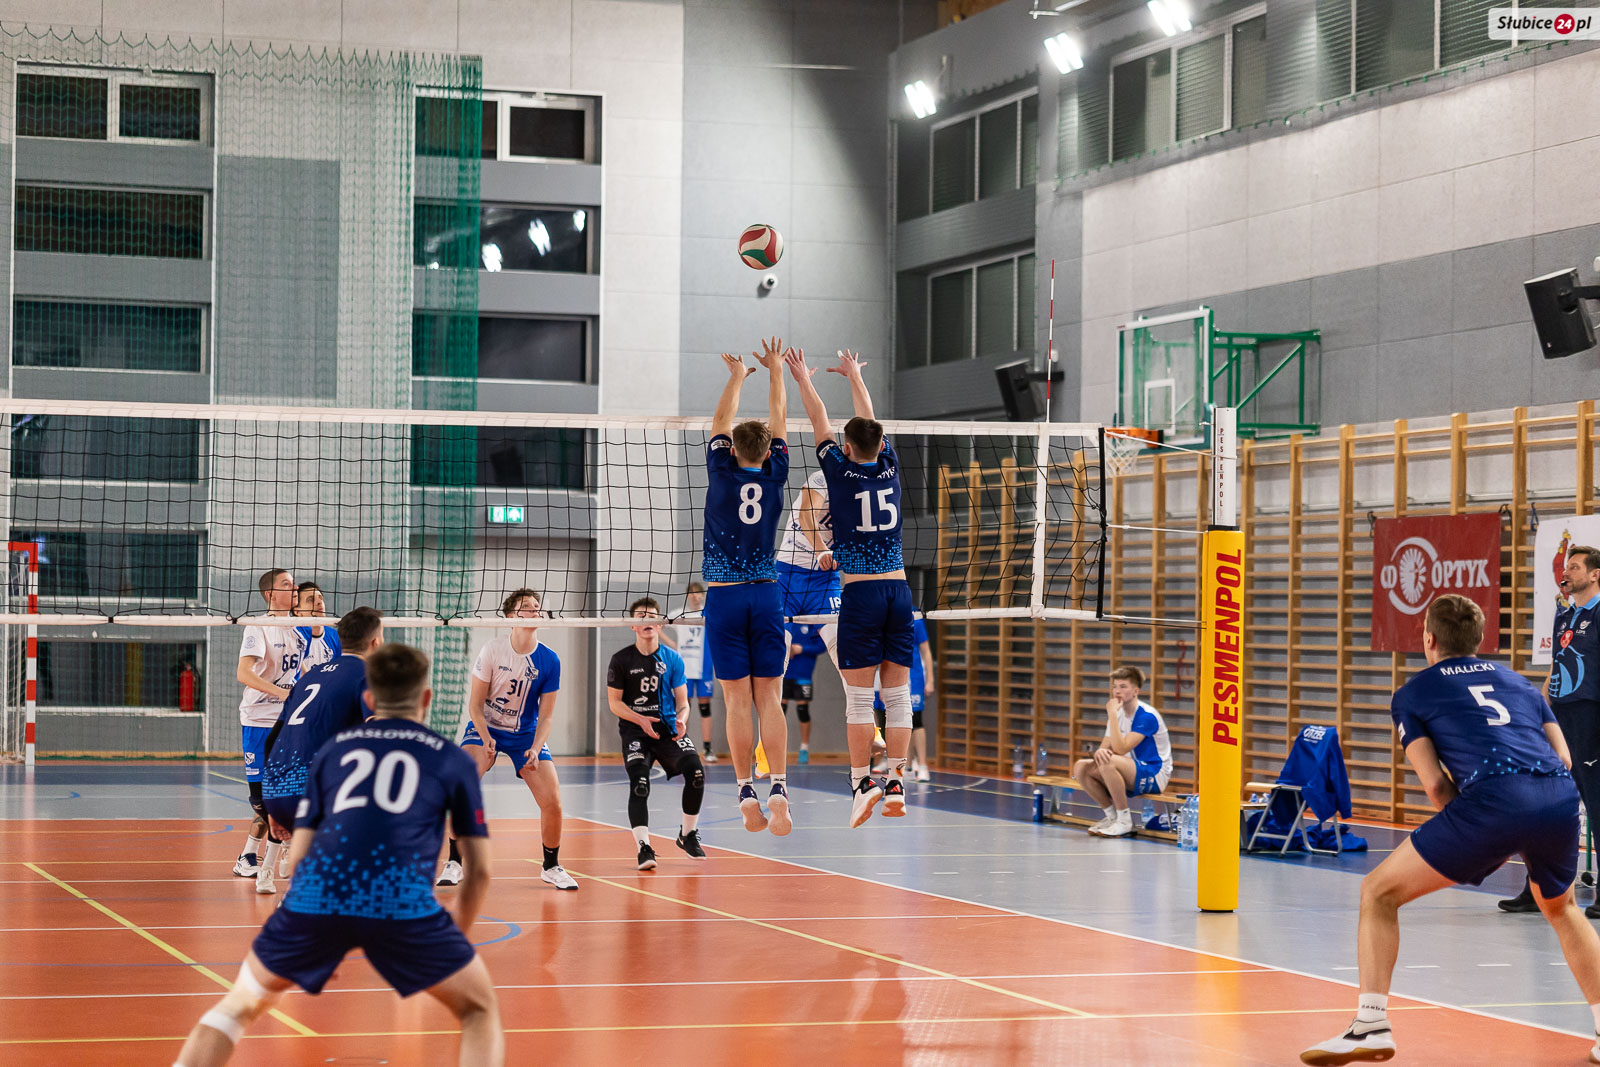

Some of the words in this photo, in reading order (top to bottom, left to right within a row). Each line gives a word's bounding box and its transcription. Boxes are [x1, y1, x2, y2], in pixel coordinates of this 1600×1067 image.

[738, 483, 763, 524] 8
[855, 487, 898, 532] 15
[1431, 559, 1490, 588] OPTYK
[1212, 549, 1242, 746] PESMENPOL
[281, 653, 299, 672] 66
[1440, 663, 1496, 676] MALICKI
[507, 679, 523, 697] 31
[640, 675, 659, 693] 69
[288, 683, 321, 726] 2
[1467, 684, 1511, 726] 5
[335, 729, 445, 751] MASŁOWSKI
[676, 738, 695, 748] 69
[333, 749, 420, 814] 20
